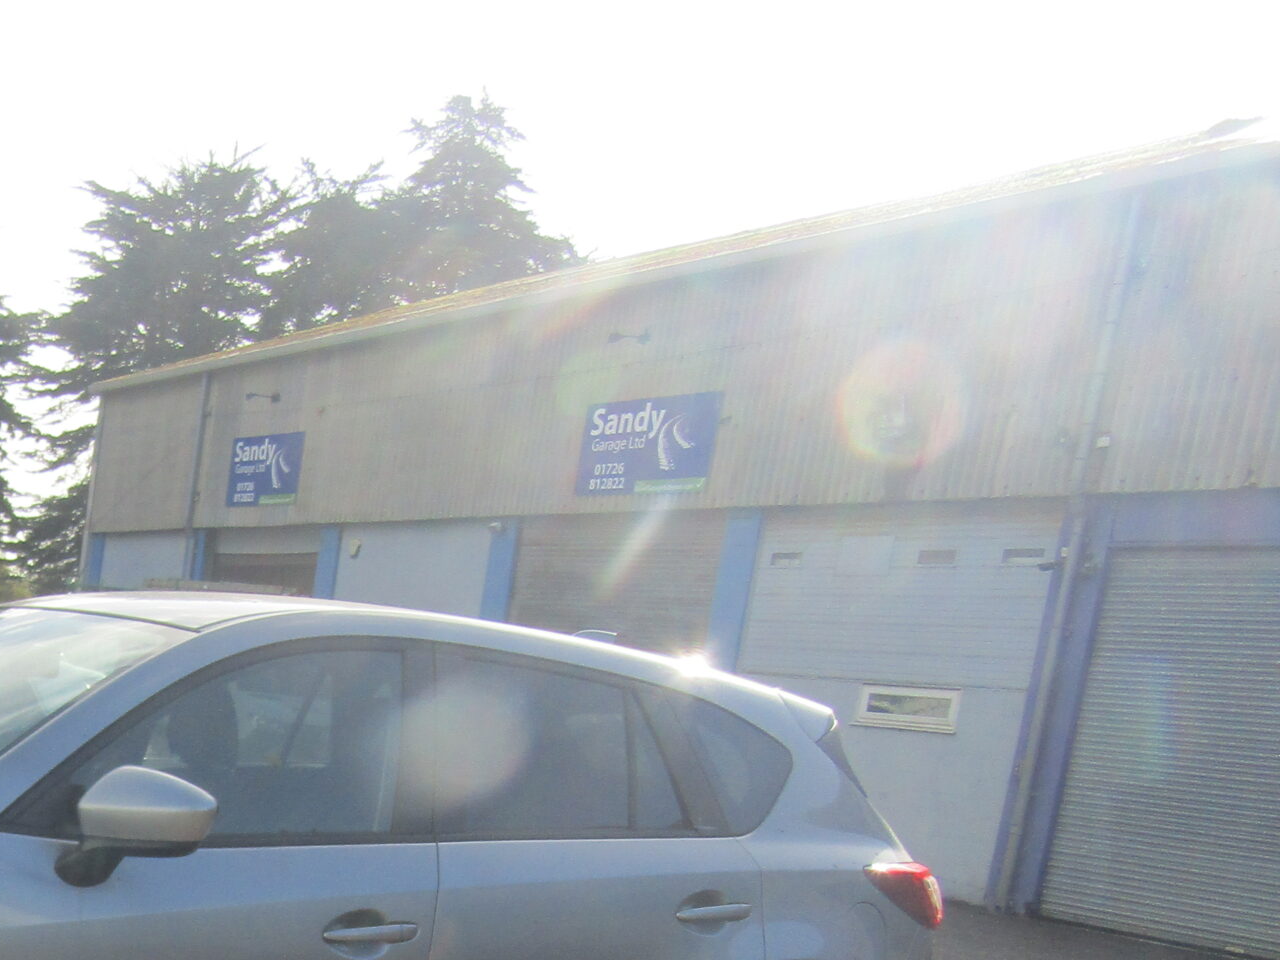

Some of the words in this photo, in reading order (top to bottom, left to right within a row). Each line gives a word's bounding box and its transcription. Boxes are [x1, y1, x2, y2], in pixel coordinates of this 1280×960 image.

[589, 402, 667, 440] Sandy
[234, 438, 276, 464] Sandy
[591, 438, 627, 454] Garage
[628, 434, 646, 449] Ltd
[594, 463, 625, 475] 01726
[588, 478, 625, 490] 812822
